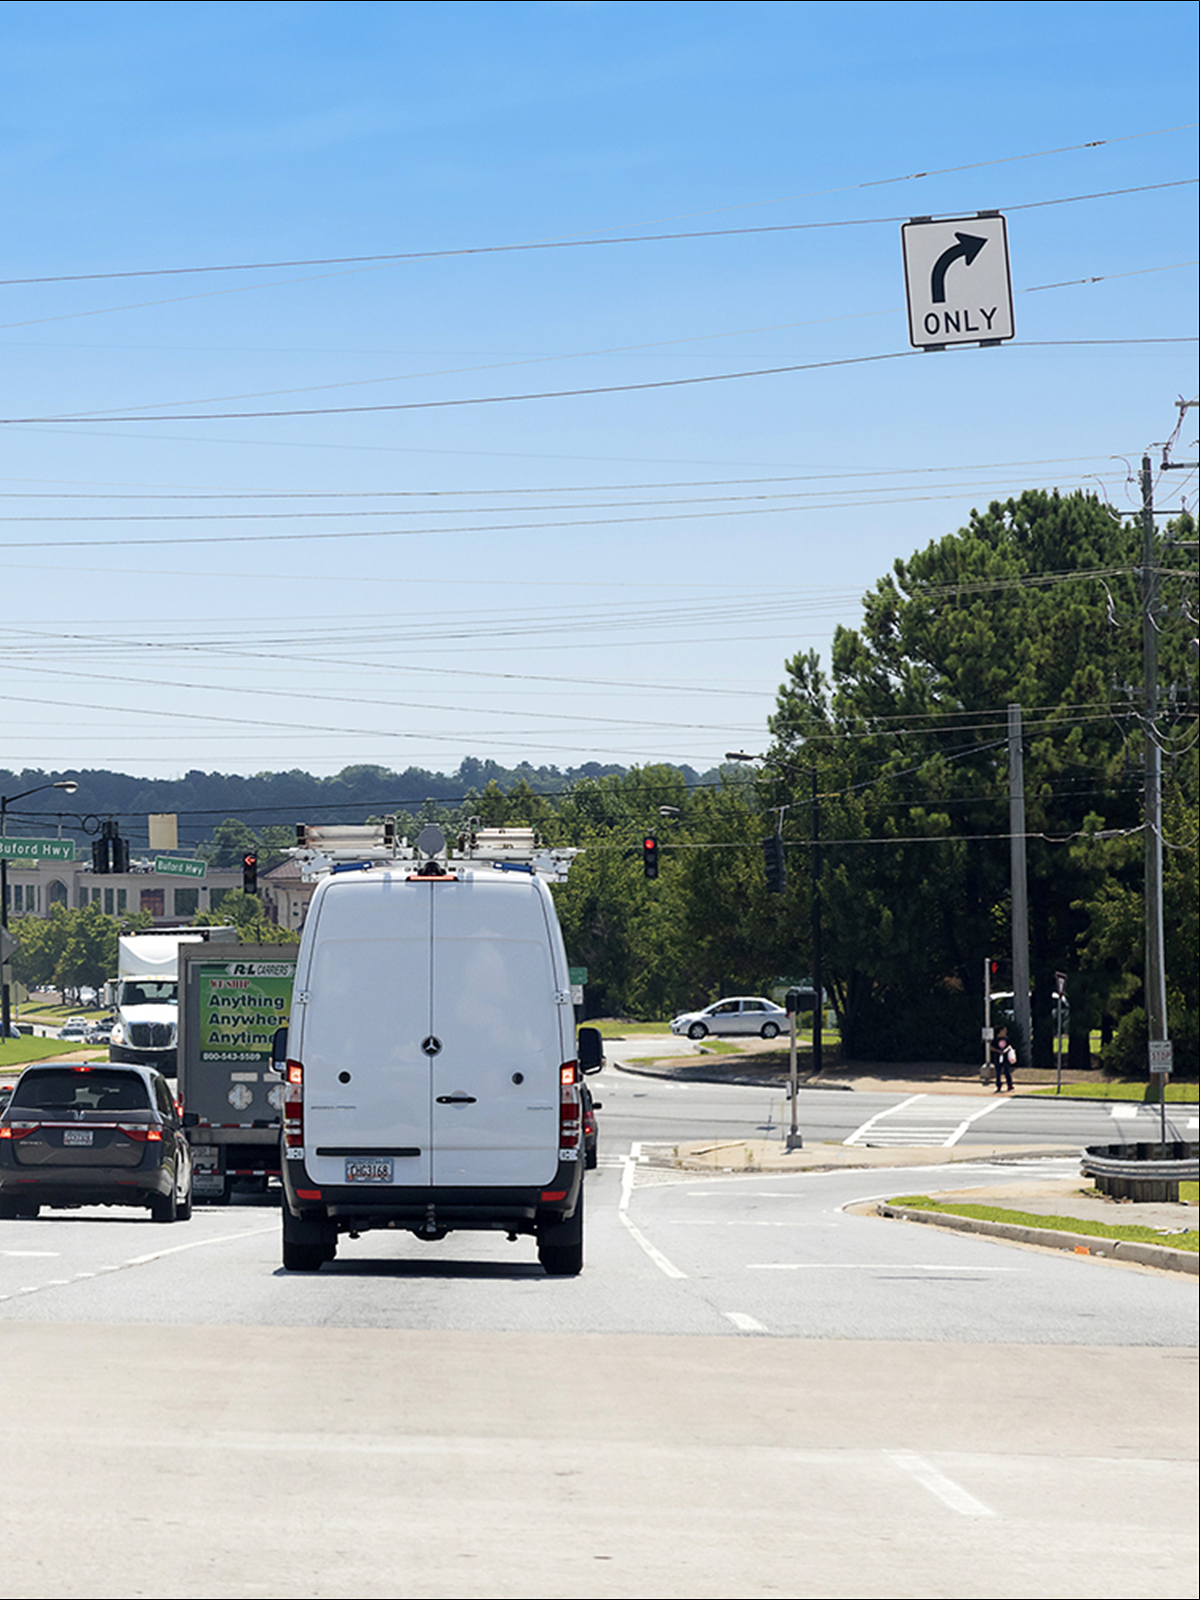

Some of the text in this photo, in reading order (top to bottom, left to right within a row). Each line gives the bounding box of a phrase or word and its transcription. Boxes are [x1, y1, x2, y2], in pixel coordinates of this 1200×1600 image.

[924, 306, 998, 335] ONLY
[42, 844, 71, 859] Hwy
[157, 859, 204, 876] Buford Hwy
[225, 979, 250, 989] SHIP
[208, 994, 285, 1010] Anything
[208, 1012, 290, 1028] Anywher
